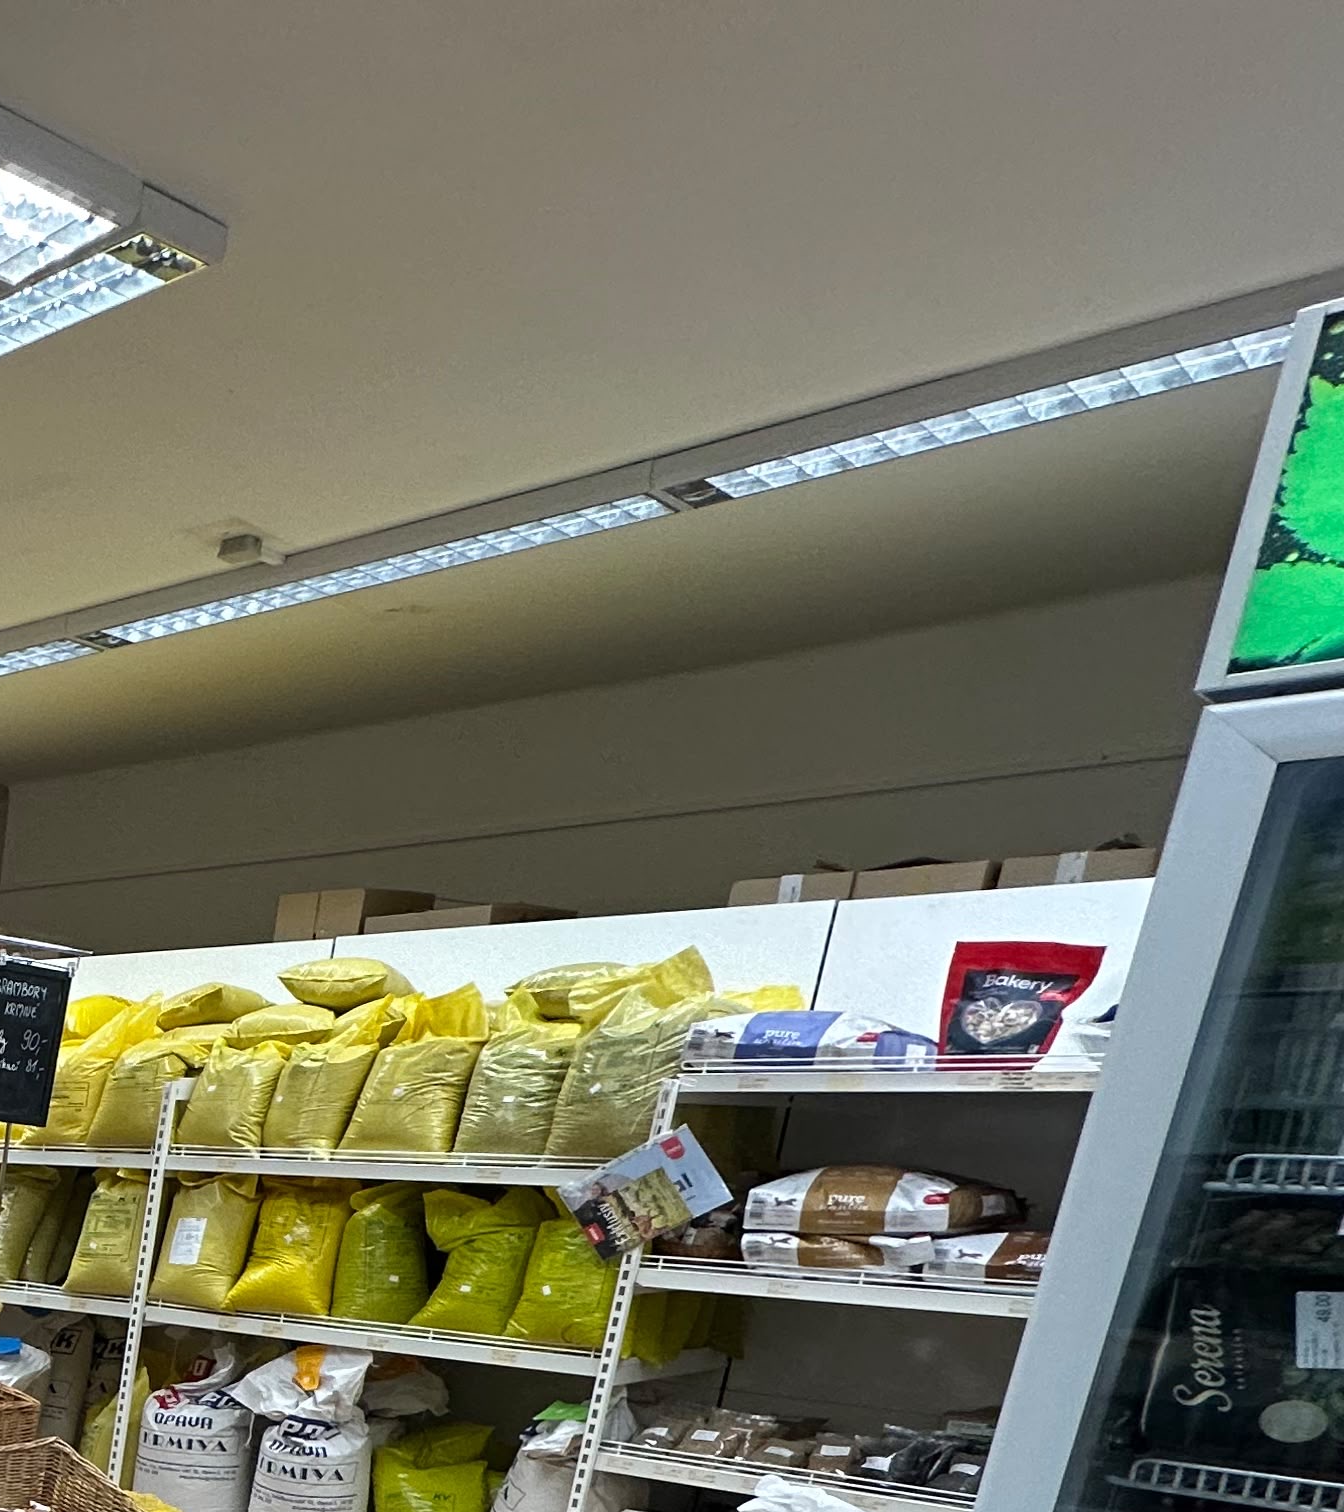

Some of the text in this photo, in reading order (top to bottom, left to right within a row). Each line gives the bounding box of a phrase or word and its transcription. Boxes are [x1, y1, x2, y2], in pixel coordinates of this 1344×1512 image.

[983, 974, 1054, 994] Bakery
[4, 1002, 41, 1019] KRMNÉ
[764, 1027, 801, 1040] pure
[827, 1193, 867, 1207] pure
[1172, 1304, 1233, 1413] Serena
[153, 1412, 214, 1430] OPAVA
